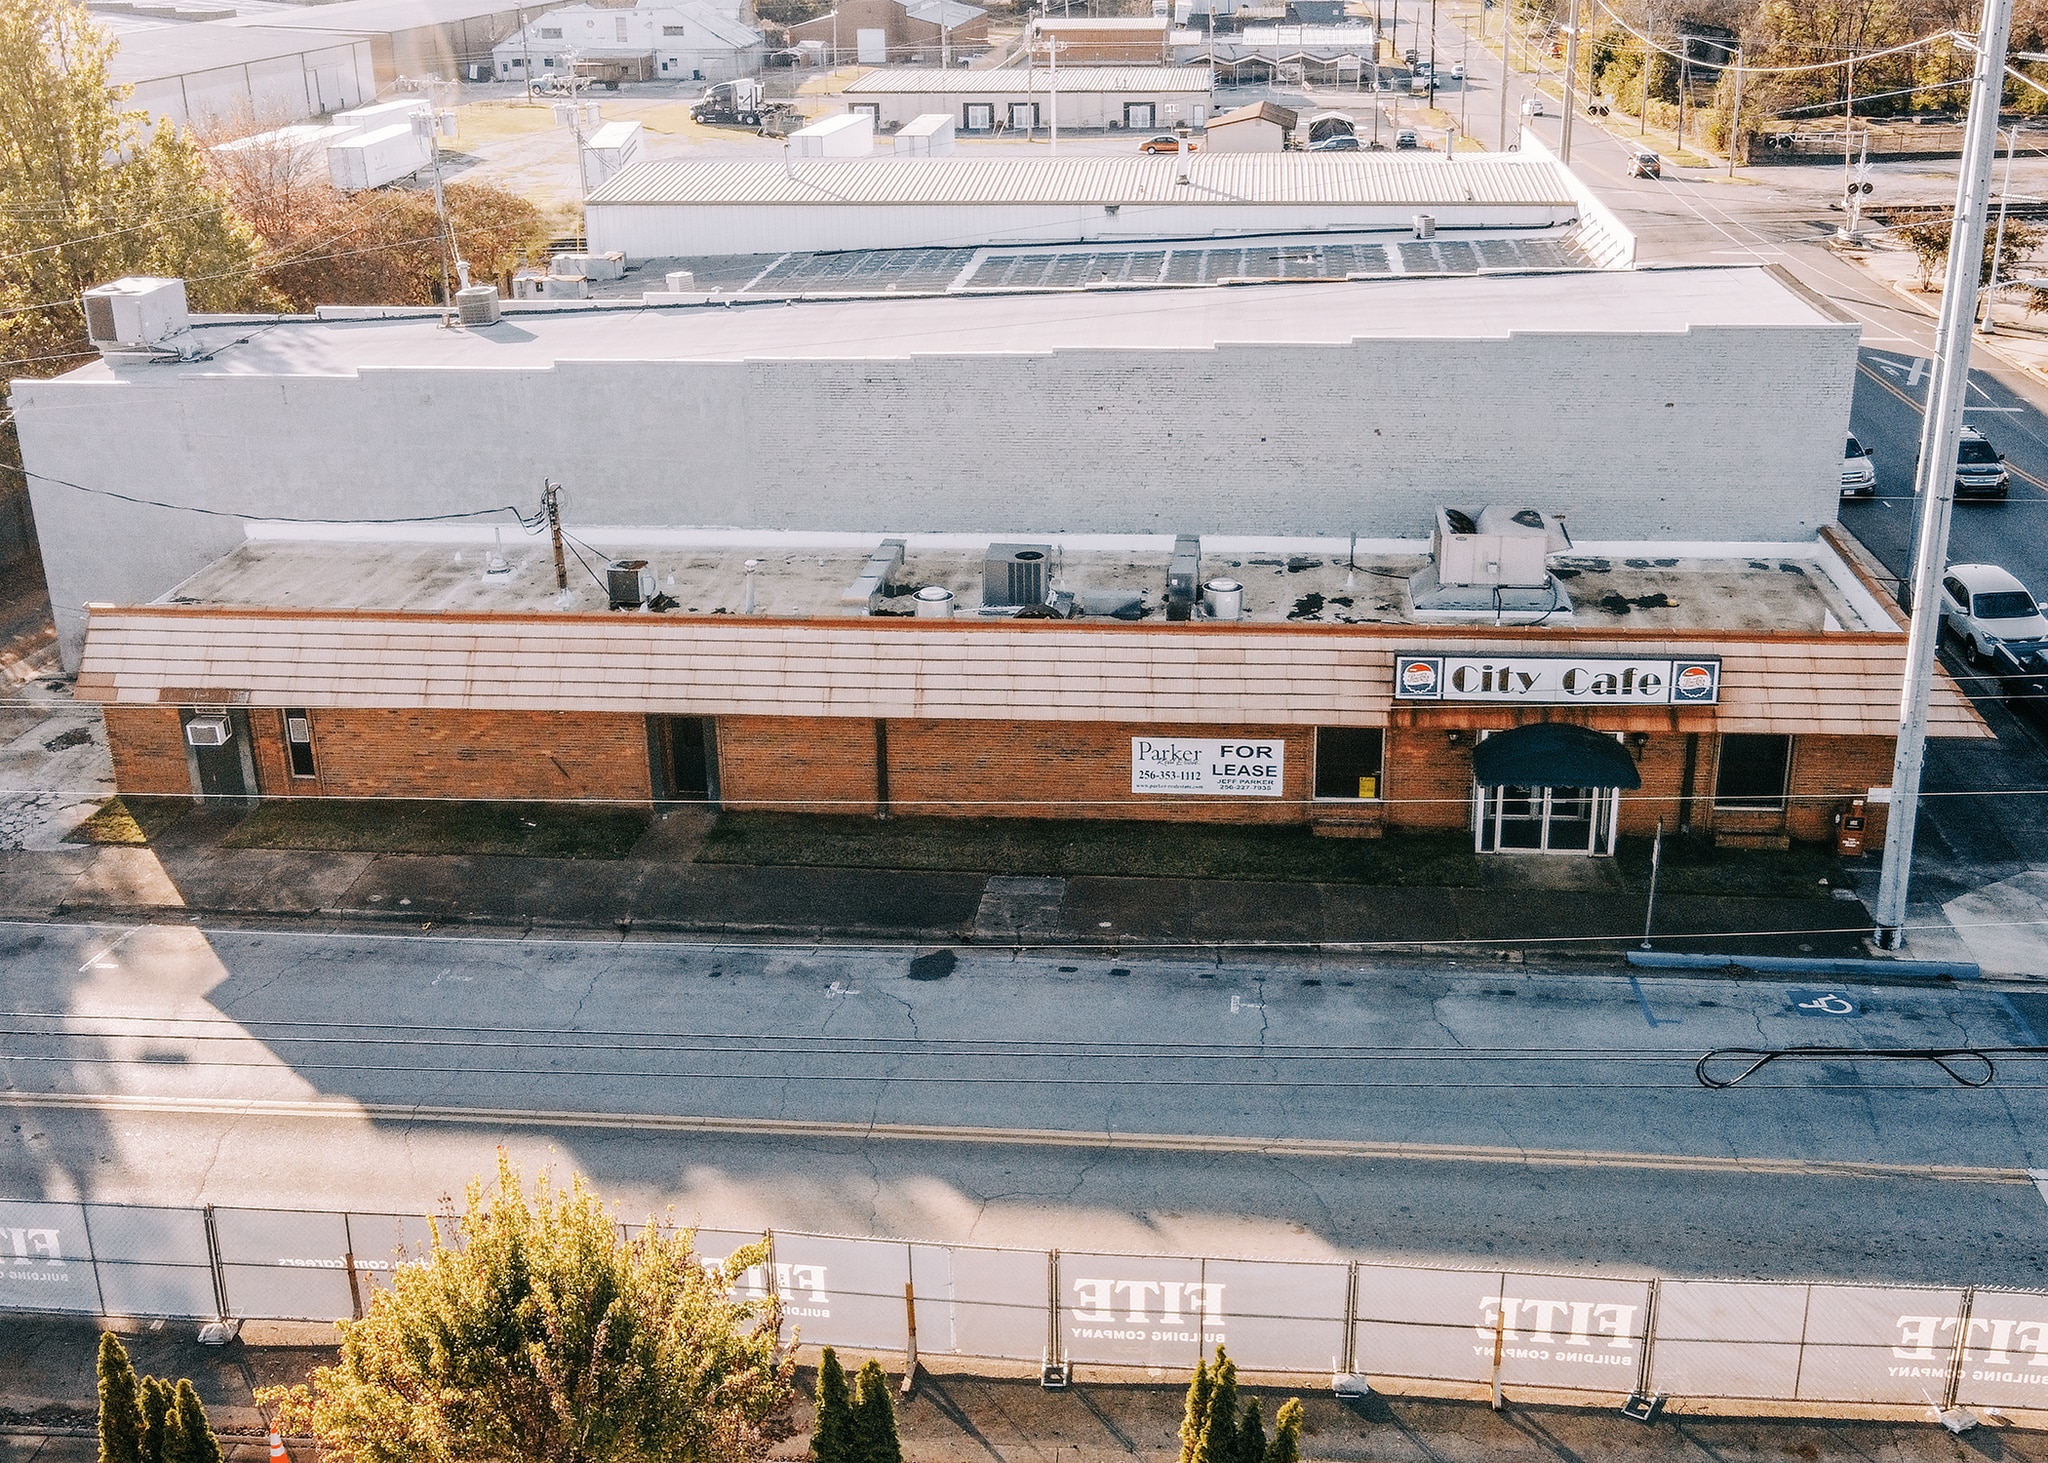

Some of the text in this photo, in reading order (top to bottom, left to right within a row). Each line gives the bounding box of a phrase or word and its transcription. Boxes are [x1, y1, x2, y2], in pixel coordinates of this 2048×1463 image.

[1452, 665, 1662, 697] City Cafe
[1138, 741, 1203, 762] Parker
[1221, 745, 1273, 759] FOR
[1138, 770, 1201, 781] 256-353-1112
[1212, 764, 1278, 778] LEASE
